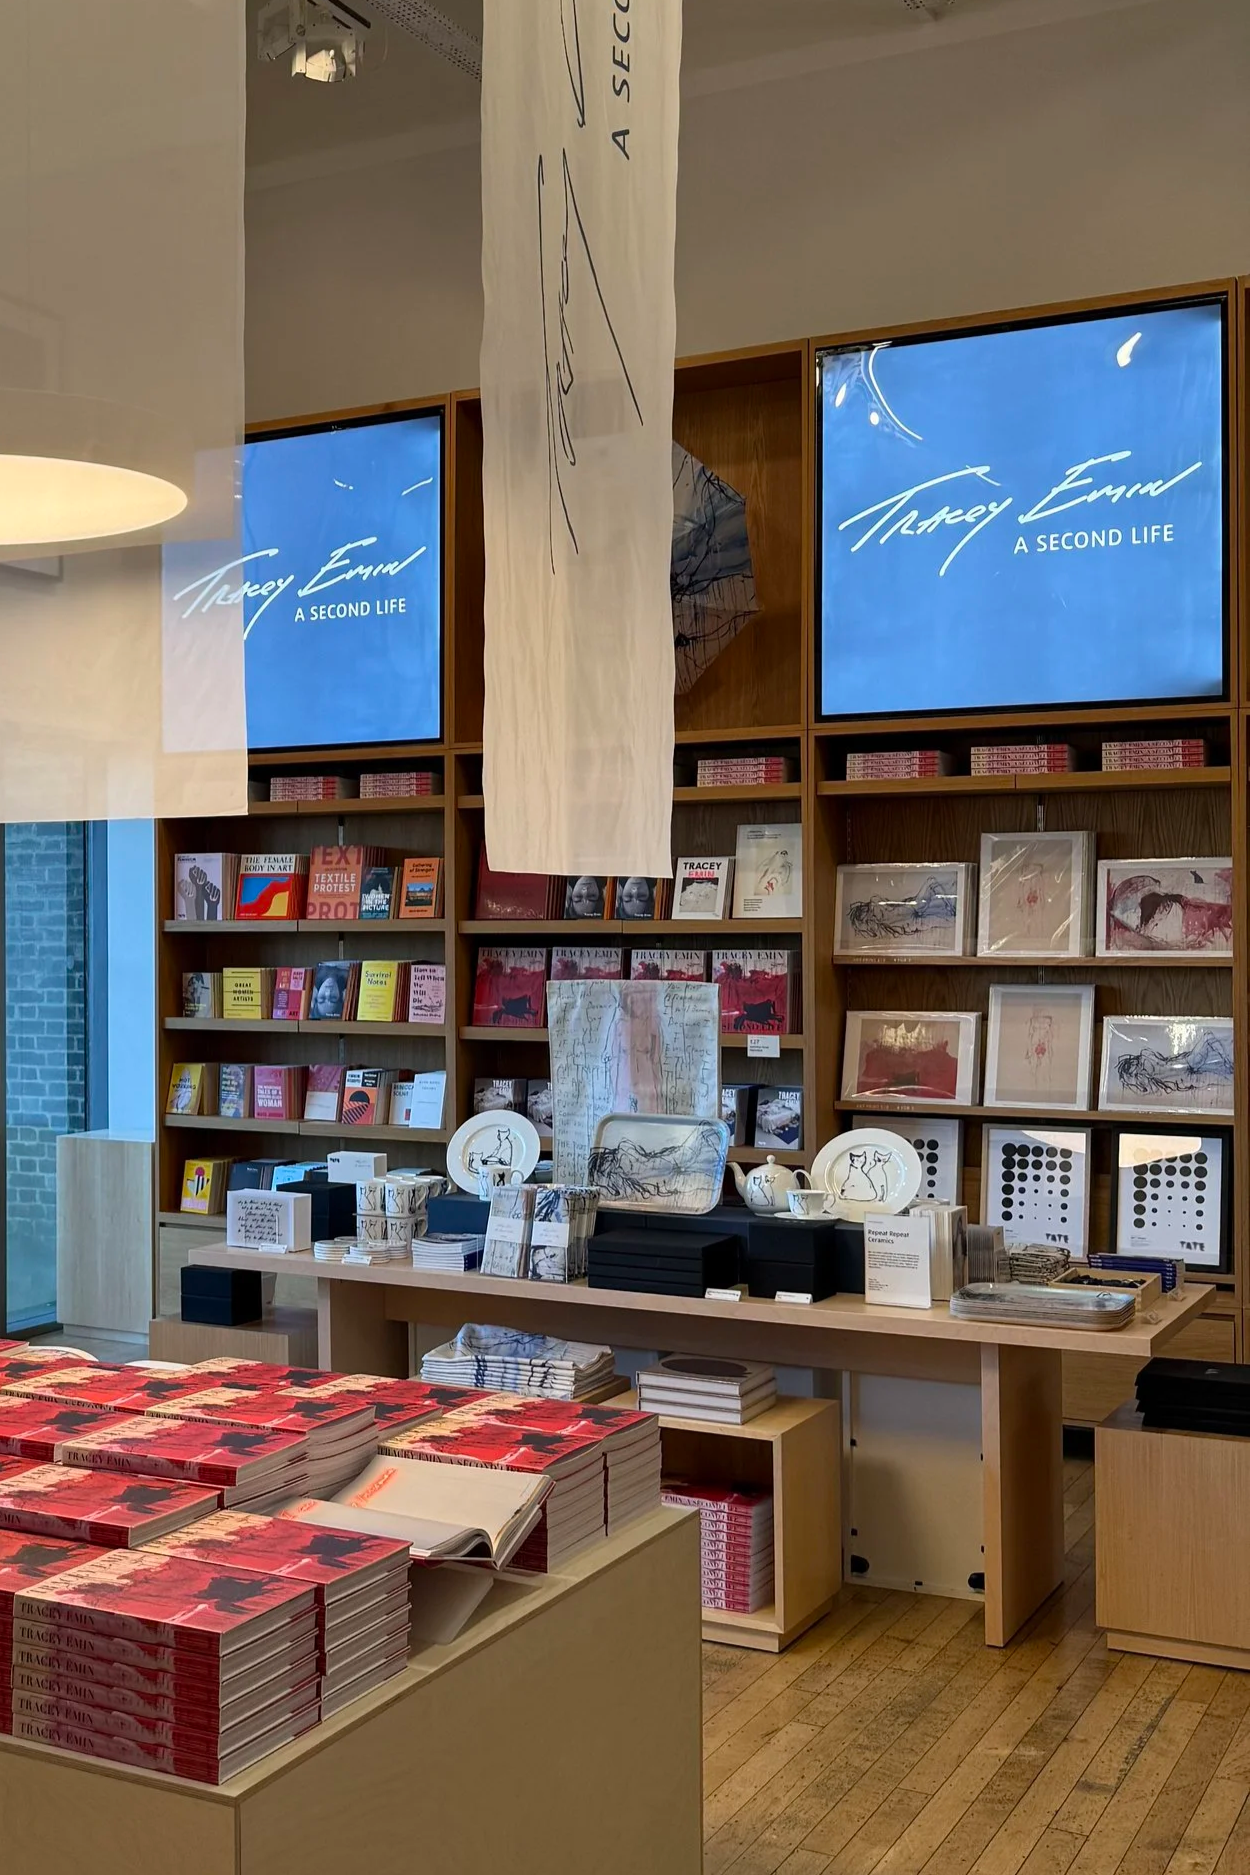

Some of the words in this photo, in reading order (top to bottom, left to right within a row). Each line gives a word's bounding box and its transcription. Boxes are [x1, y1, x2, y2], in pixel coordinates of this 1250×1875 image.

[612, 129, 630, 160] A
[1013, 536, 1029, 554] A
[1036, 528, 1122, 552] SECOND
[1131, 524, 1174, 544] LIFE
[295, 607, 305, 622] A
[310, 601, 370, 620] SECOND
[376, 598, 406, 615] LIFE
[264, 856, 293, 864] FEMALE
[244, 864, 264, 872] BODY
[683, 861, 722, 870] TRACEY
[315, 873, 356, 883] TEXTILE
[313, 883, 356, 893] PROTEST
[482, 949, 516, 959] TRACEY
[520, 949, 544, 958] EMIN
[556, 949, 591, 958] TRACEY
[595, 949, 619, 958] EMIN
[634, 951, 670, 959] TRACEY
[675, 951, 700, 959] EMIN
[715, 951, 753, 959] TRACEY
[757, 951, 783, 959] EMIN
[365, 970, 391, 978] Survival
[367, 978, 387, 986] Notes
[493, 1080, 512, 1088] TRACEY
[778, 1091, 800, 1100] TRACEY
[257, 1099, 282, 1108] WOMAN
[867, 1229, 887, 1237] Repeat
[889, 1230, 910, 1238] Repeat
[1045, 1233, 1069, 1243] TATE
[867, 1236, 894, 1244] Ceramics
[1179, 1241, 1205, 1251] TATE
[66, 1450, 106, 1464] TRACEY
[106, 1454, 132, 1468] EMIN
[419, 1451, 442, 1462] EMIN
[20, 1602, 61, 1620] TRACEY
[66, 1611, 94, 1625] EMIN
[20, 1627, 61, 1644] TRACEY
[66, 1636, 94, 1651] EMIN
[19, 1651, 61, 1669] TRACEY
[66, 1661, 94, 1676] EMIN
